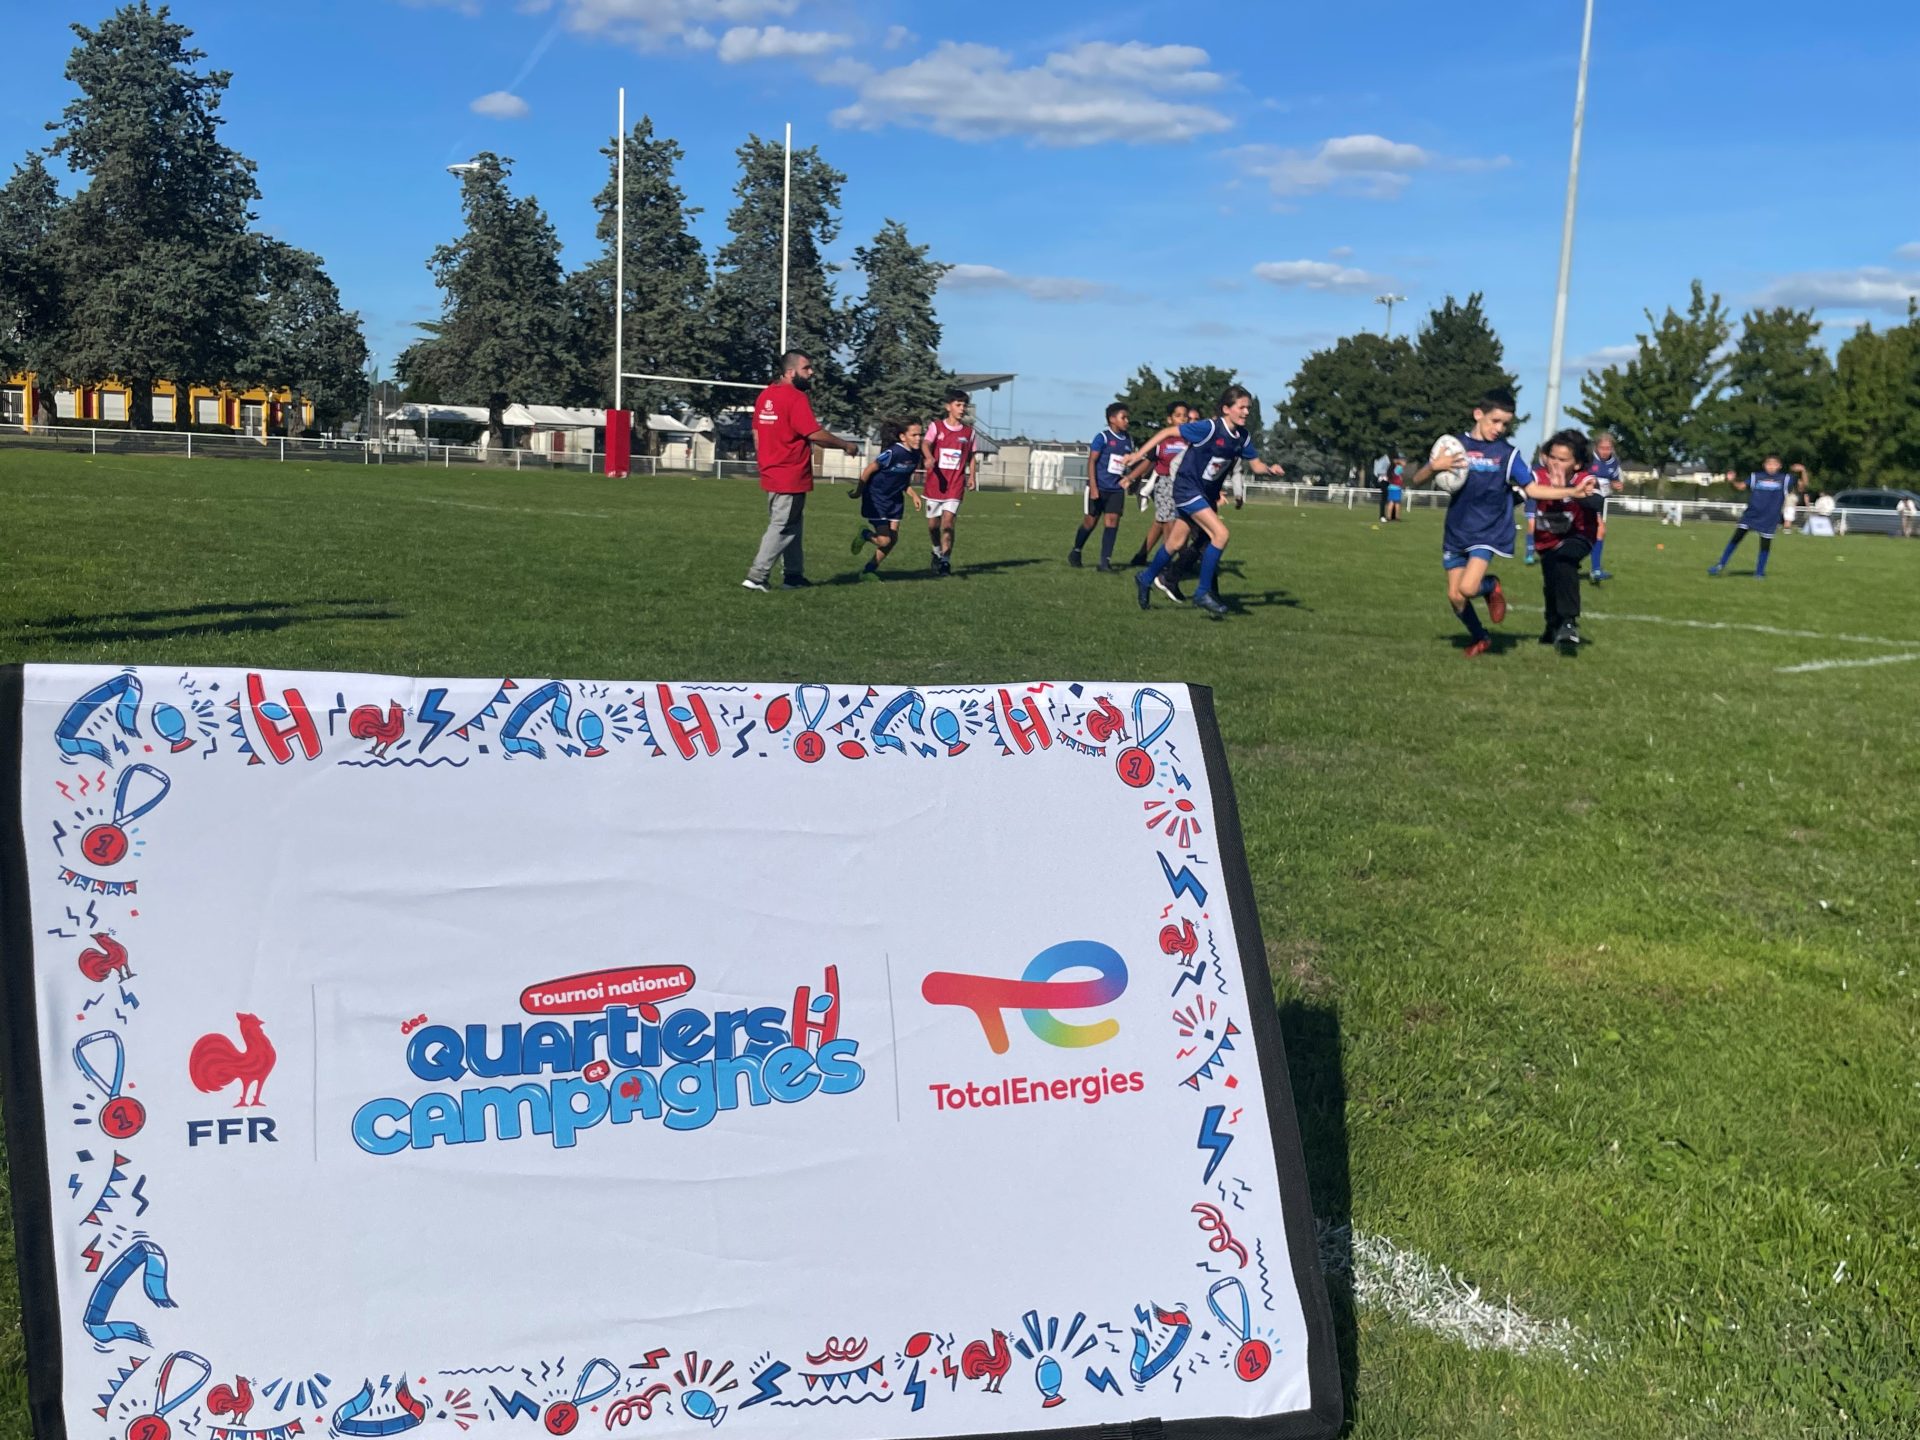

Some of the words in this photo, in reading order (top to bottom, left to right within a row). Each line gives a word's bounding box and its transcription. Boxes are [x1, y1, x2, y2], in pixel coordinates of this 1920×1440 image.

[803, 737, 815, 756] 1
[1126, 756, 1142, 780] 1
[93, 834, 114, 857] 1
[530, 982, 604, 1007] Tournoi
[608, 972, 687, 996] national
[401, 1014, 428, 1034] des
[588, 1065, 604, 1078] et
[929, 1067, 1144, 1110] TotalEnergies
[112, 1106, 133, 1130] 1
[187, 1116, 279, 1147] FFR
[1244, 1348, 1261, 1374] 1
[551, 1408, 569, 1428] 1
